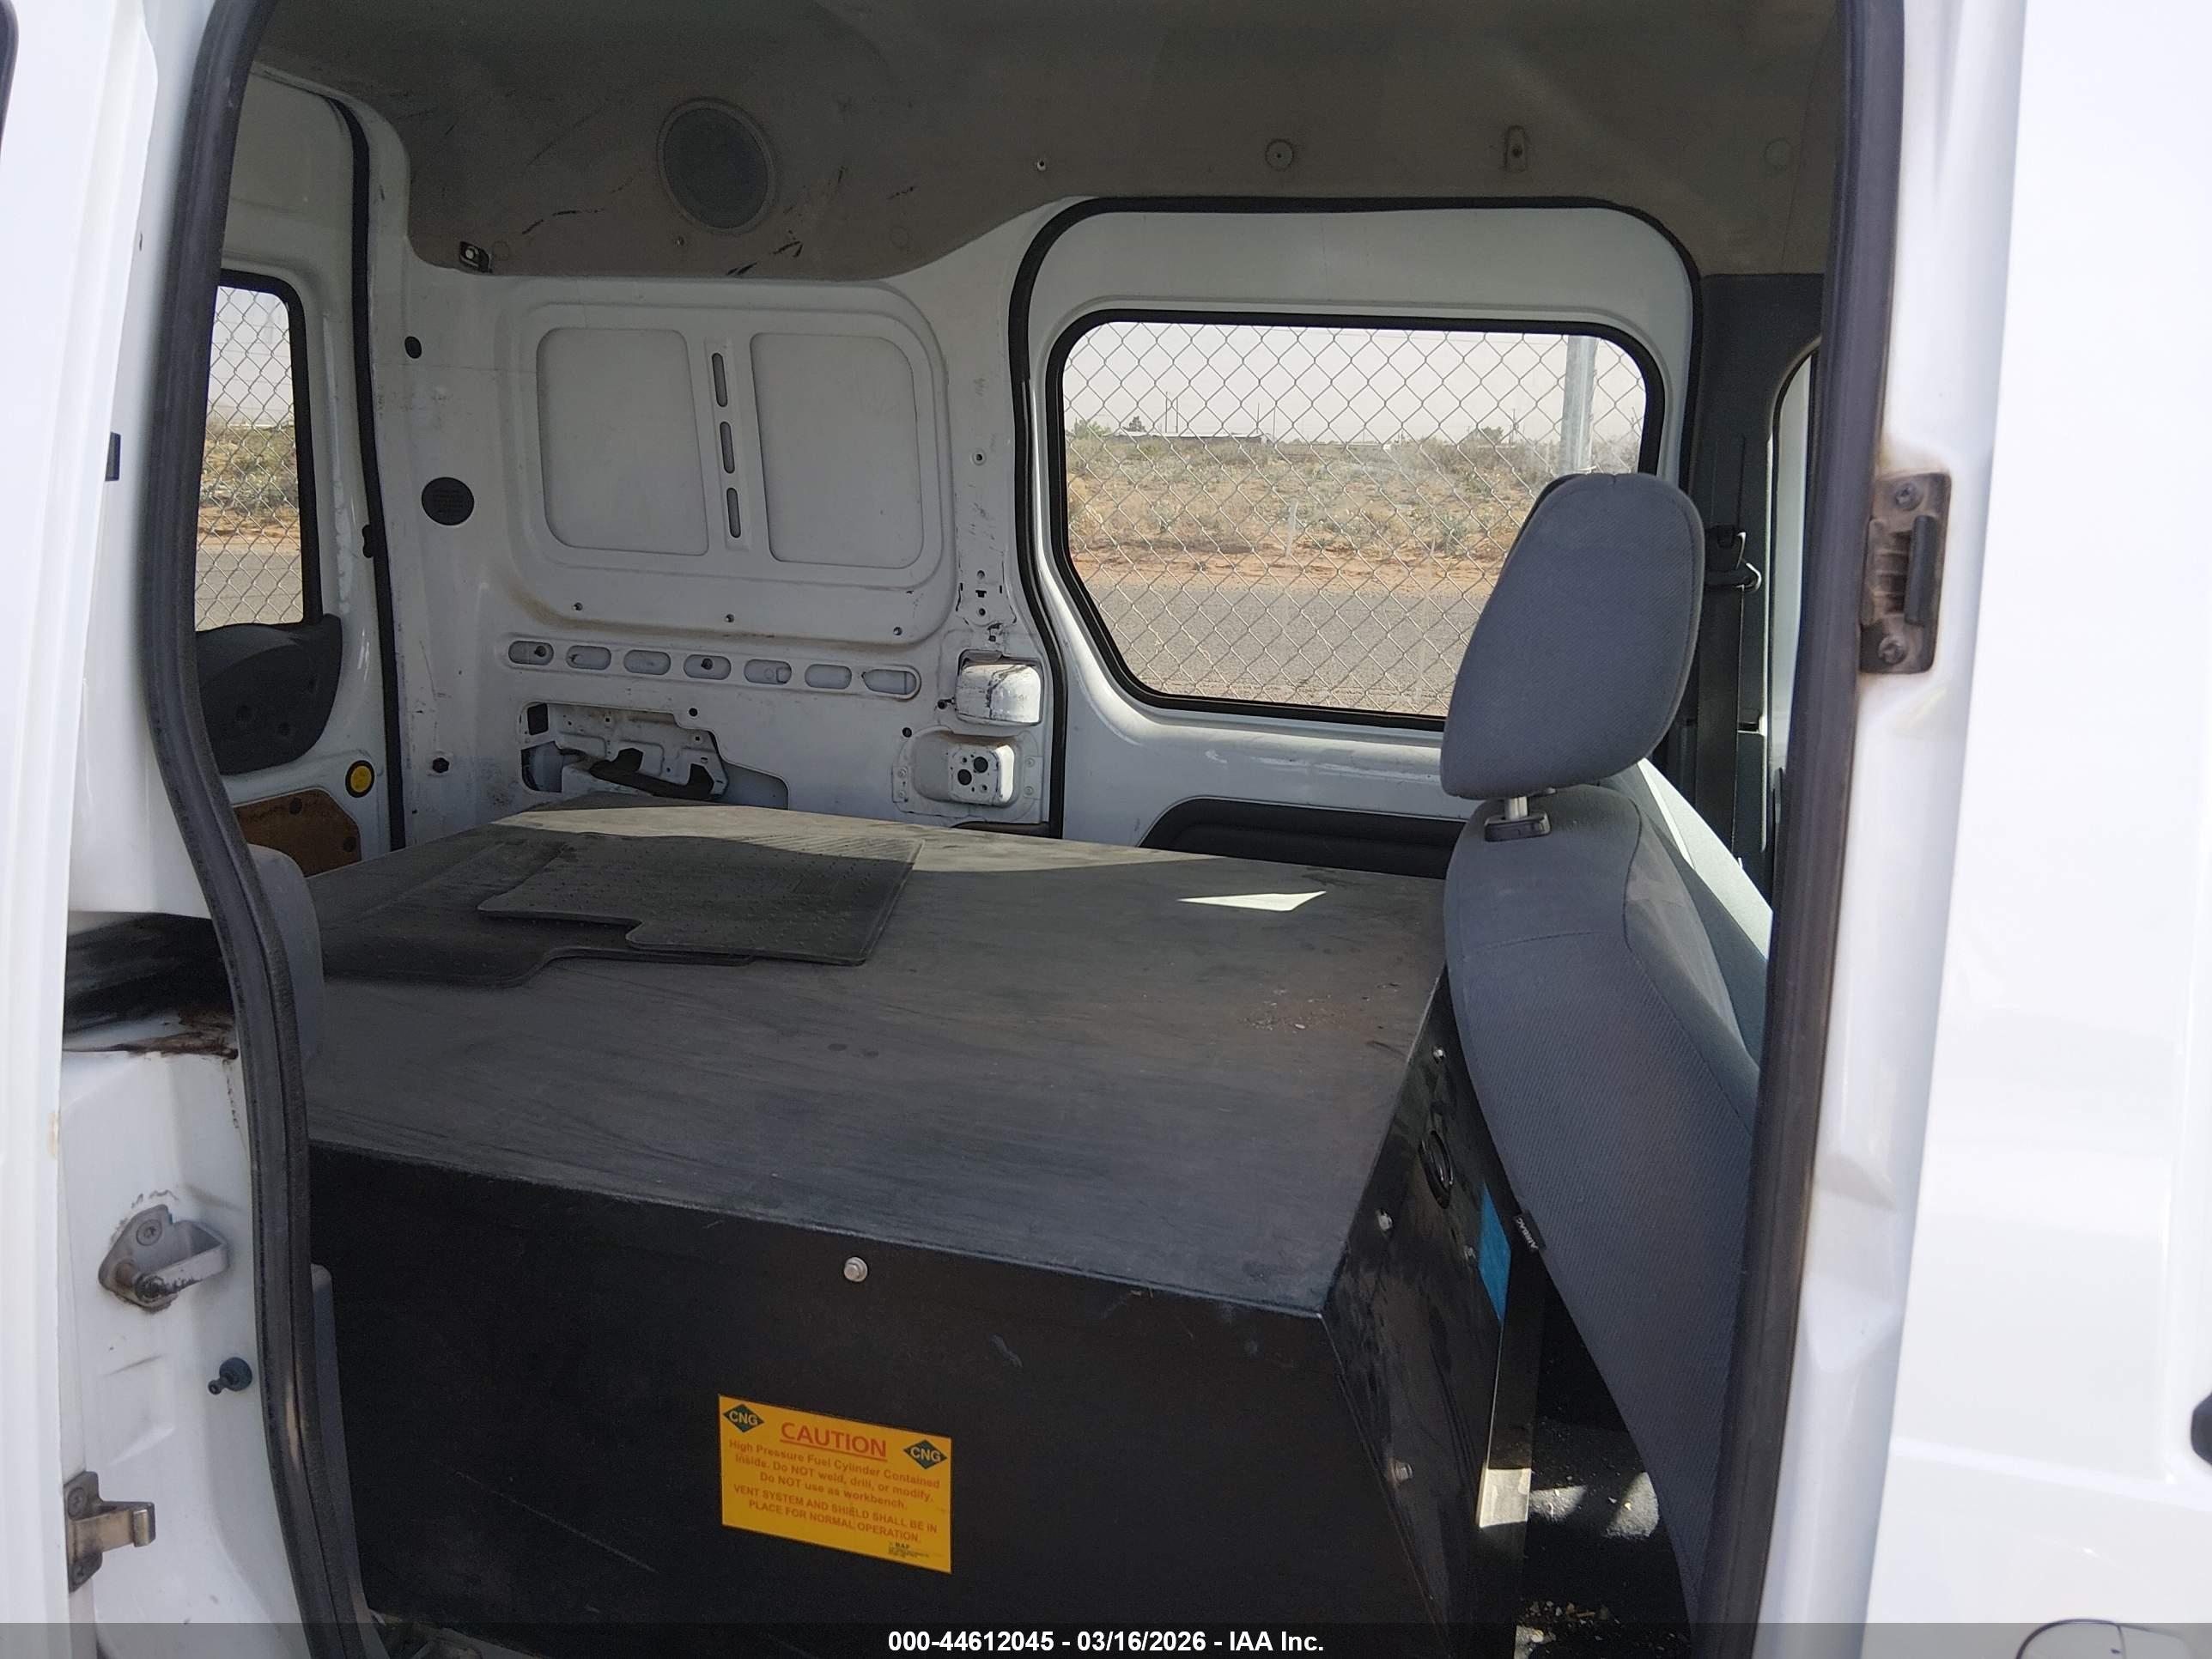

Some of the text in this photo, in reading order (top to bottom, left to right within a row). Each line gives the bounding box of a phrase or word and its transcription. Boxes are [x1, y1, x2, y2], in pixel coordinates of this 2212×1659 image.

[1516, 1217, 1539, 1249] AIRBAG
[729, 1410, 757, 1425] CNG
[781, 1422, 886, 1457] CAUTION
[910, 1447, 940, 1462] CNG
[729, 1439, 940, 1488] High Pressure Fuel Cylinder Contained
[736, 1454, 769, 1468] Inside.
[773, 1462, 787, 1472] Do
[791, 1465, 814, 1477] NOT
[850, 1476, 874, 1491] drill,
[893, 1486, 934, 1502] modify.
[760, 1471, 775, 1483] Do
[778, 1476, 800, 1488] NOT
[805, 1484, 824, 1492] use
[828, 1486, 840, 1496] as
[733, 1484, 938, 1533] VENT SYSTEM AND SHIELD SHALL BE IN
[749, 1499, 782, 1515] PLACE
[785, 1507, 806, 1519] FOR
[809, 1512, 854, 1529] NORMAL
